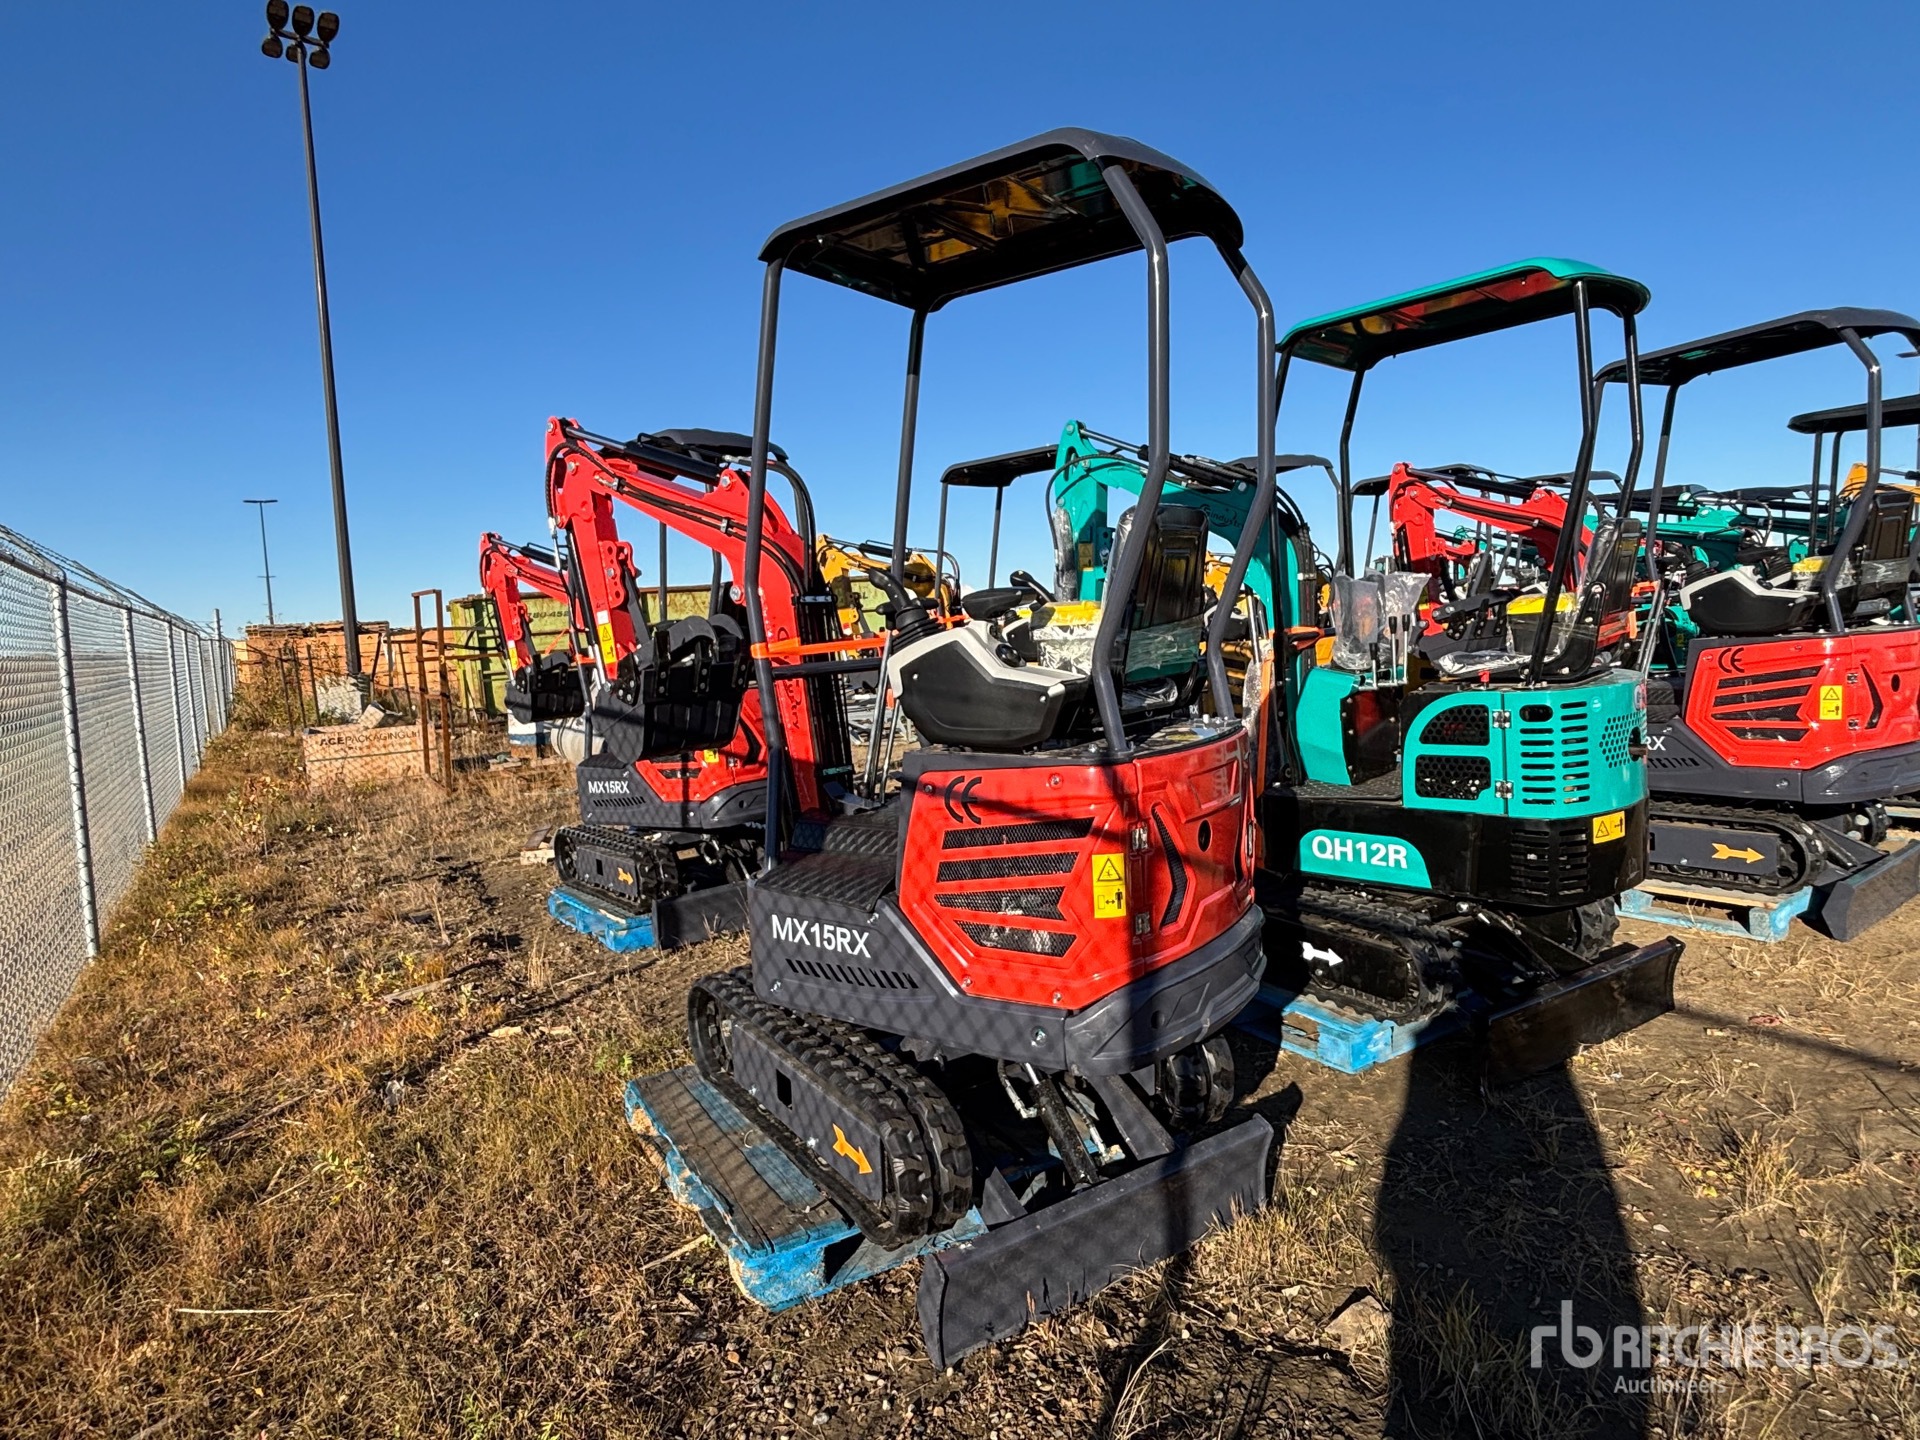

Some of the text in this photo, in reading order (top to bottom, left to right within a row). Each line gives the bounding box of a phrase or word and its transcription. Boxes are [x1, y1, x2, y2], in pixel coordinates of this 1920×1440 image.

[587, 780, 630, 794] MX15RX
[1311, 835, 1408, 869] QH12R
[771, 914, 872, 958] MX15RX
